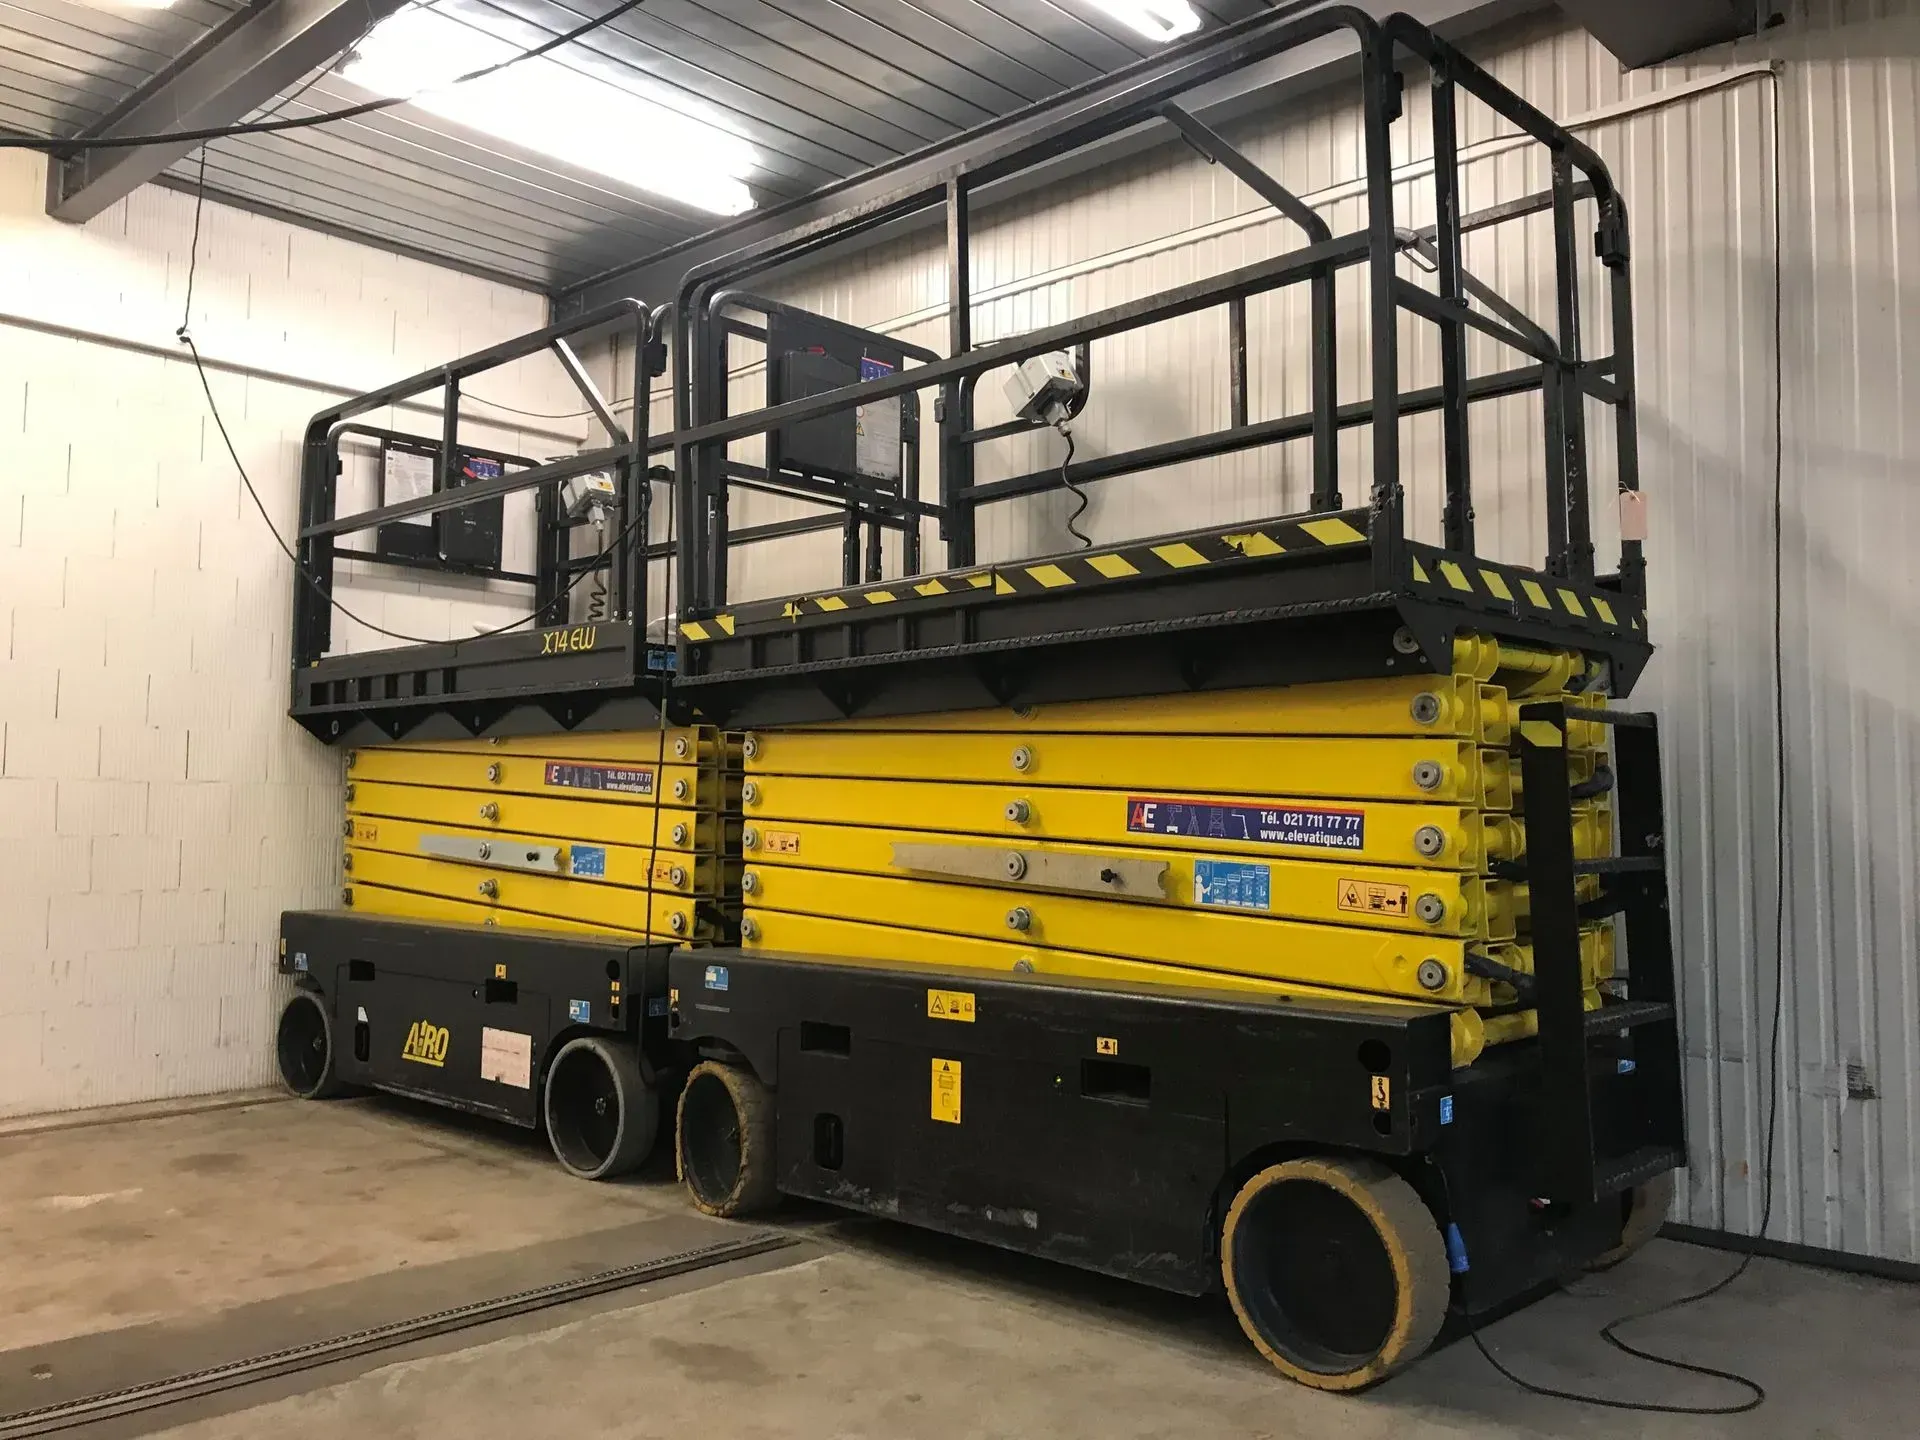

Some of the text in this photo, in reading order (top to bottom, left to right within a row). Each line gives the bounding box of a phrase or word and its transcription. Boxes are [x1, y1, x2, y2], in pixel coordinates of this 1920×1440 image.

[541, 626, 596, 654] X14 EW
[1260, 811, 1361, 830] Tél. 021 711 77 77
[1260, 829, 1360, 846] www.elevatique.ch
